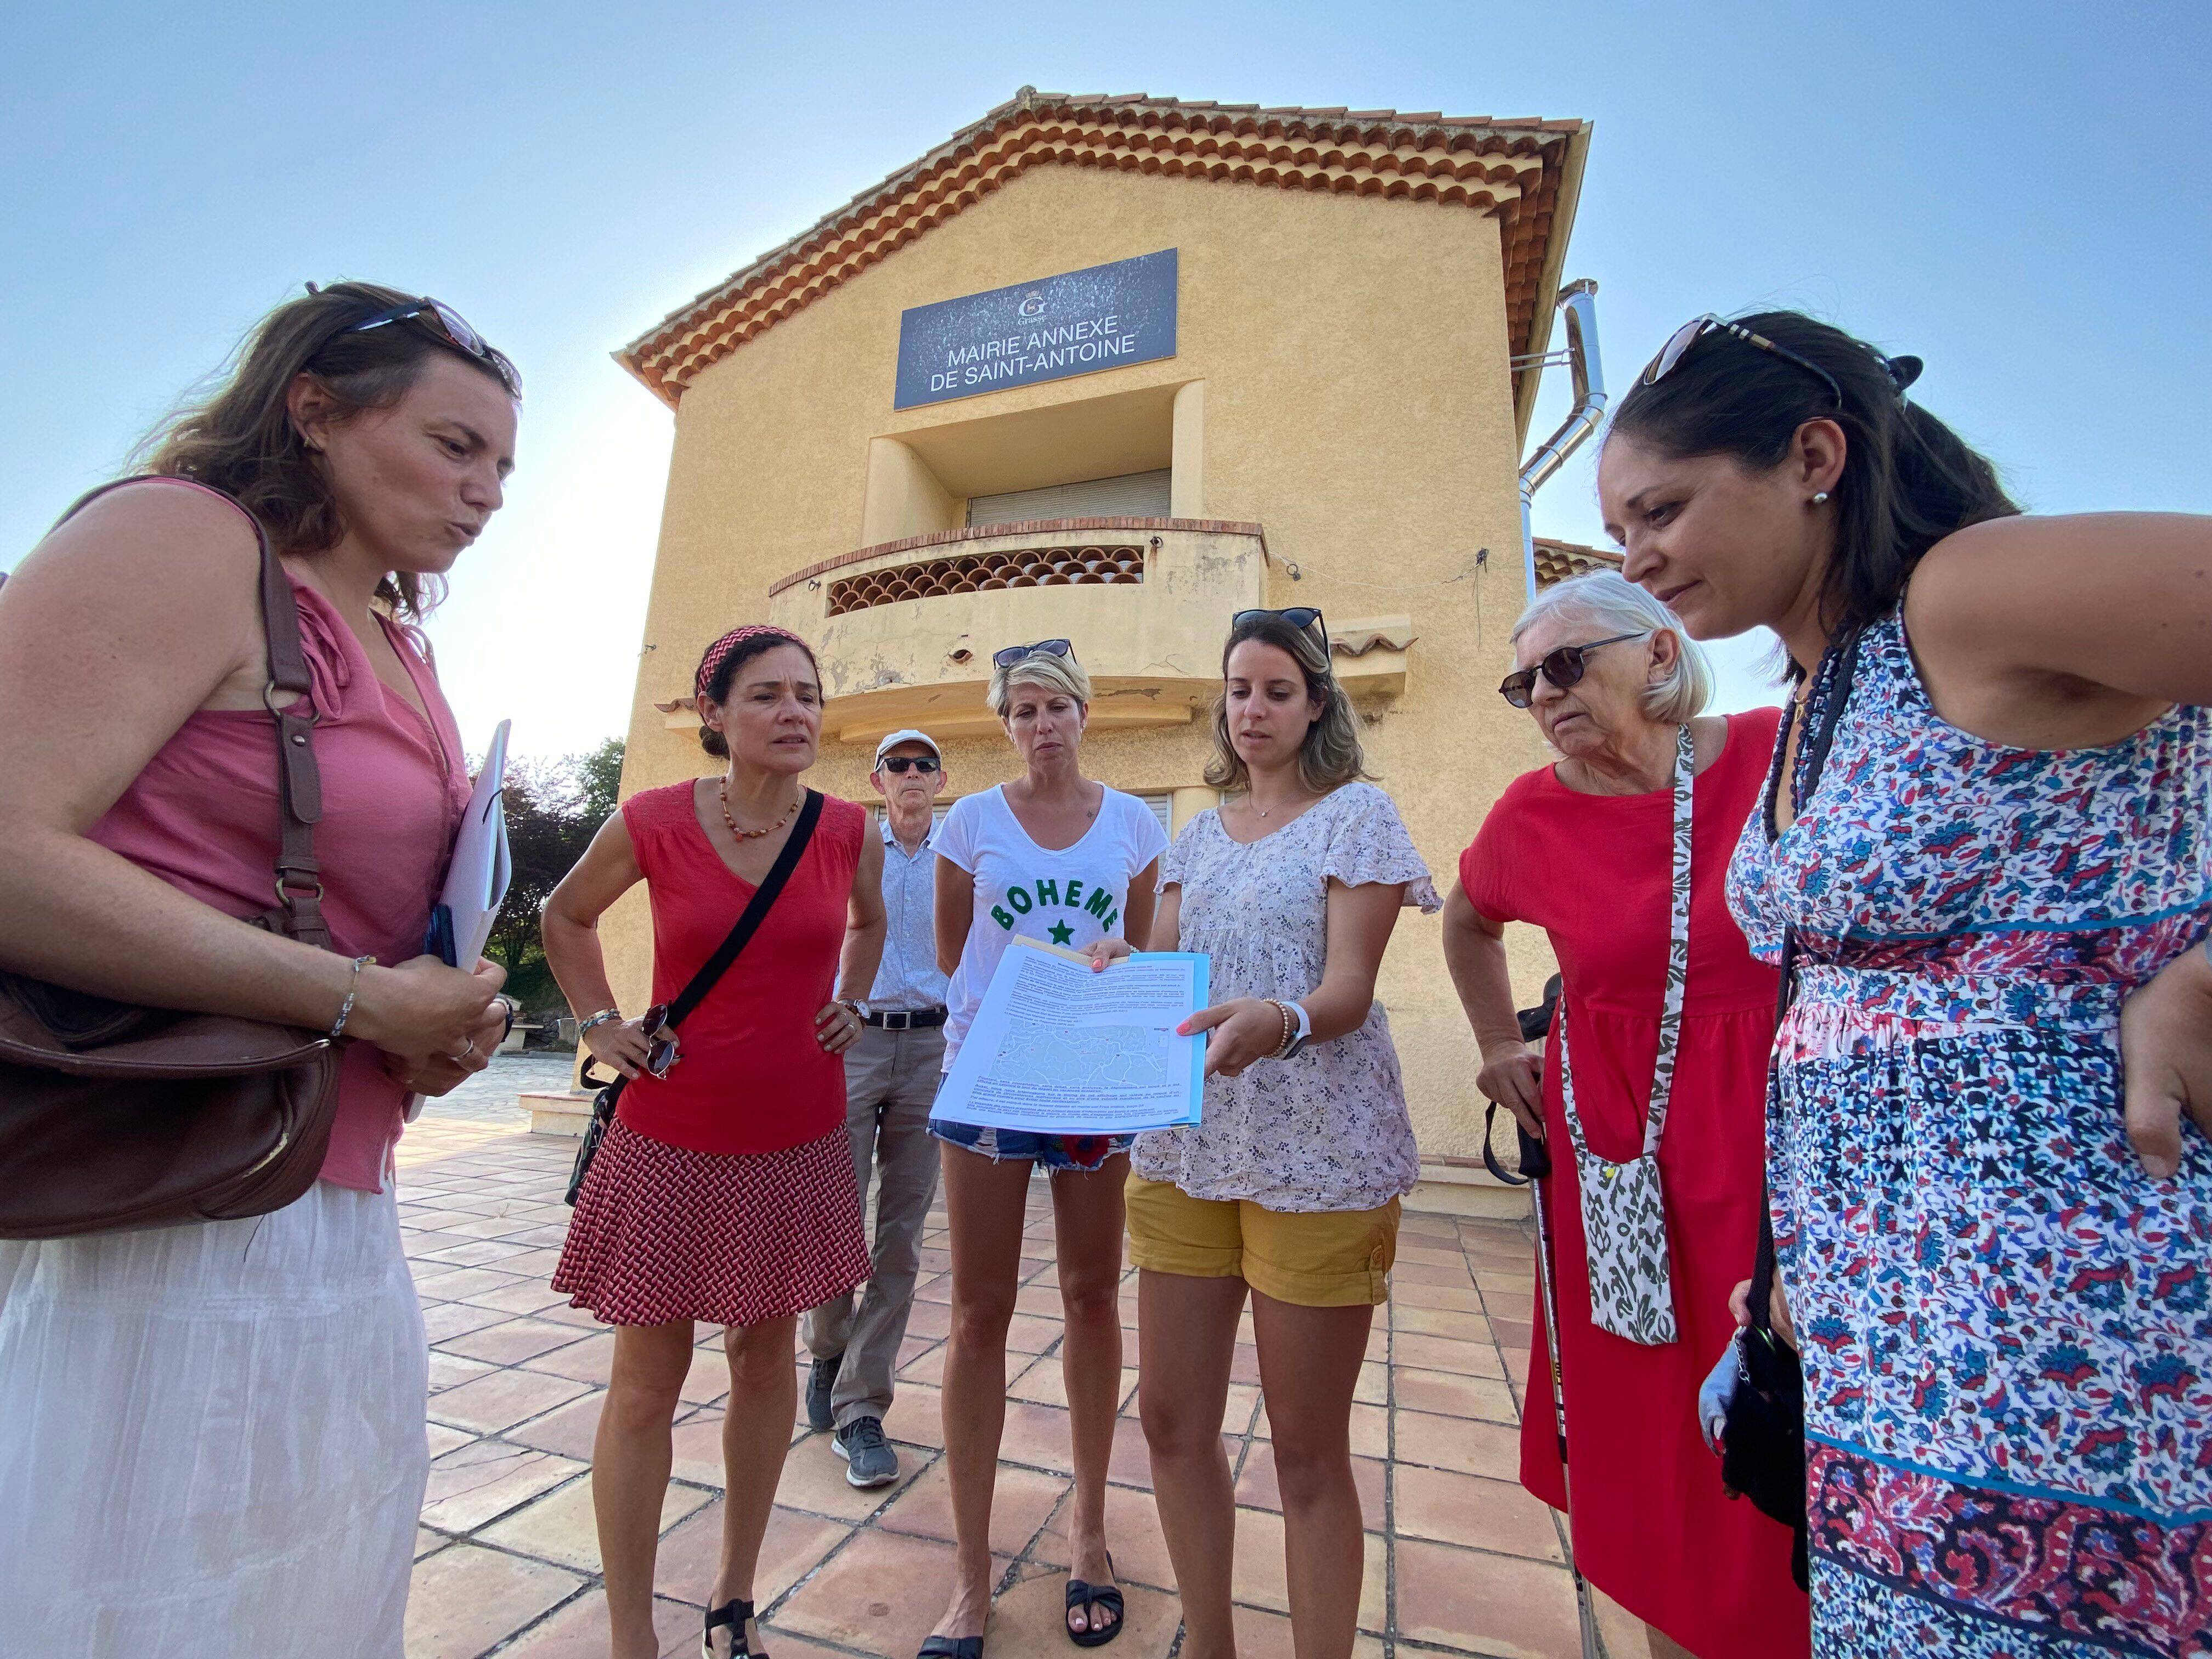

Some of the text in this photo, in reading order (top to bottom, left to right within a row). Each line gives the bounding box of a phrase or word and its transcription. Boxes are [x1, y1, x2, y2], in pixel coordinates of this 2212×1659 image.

[930, 334, 1136, 392] DE SAINT-ANTOINE
[947, 315, 1119, 366] MAIRIE ANNEXE
[991, 879, 1118, 933] BOHEME
